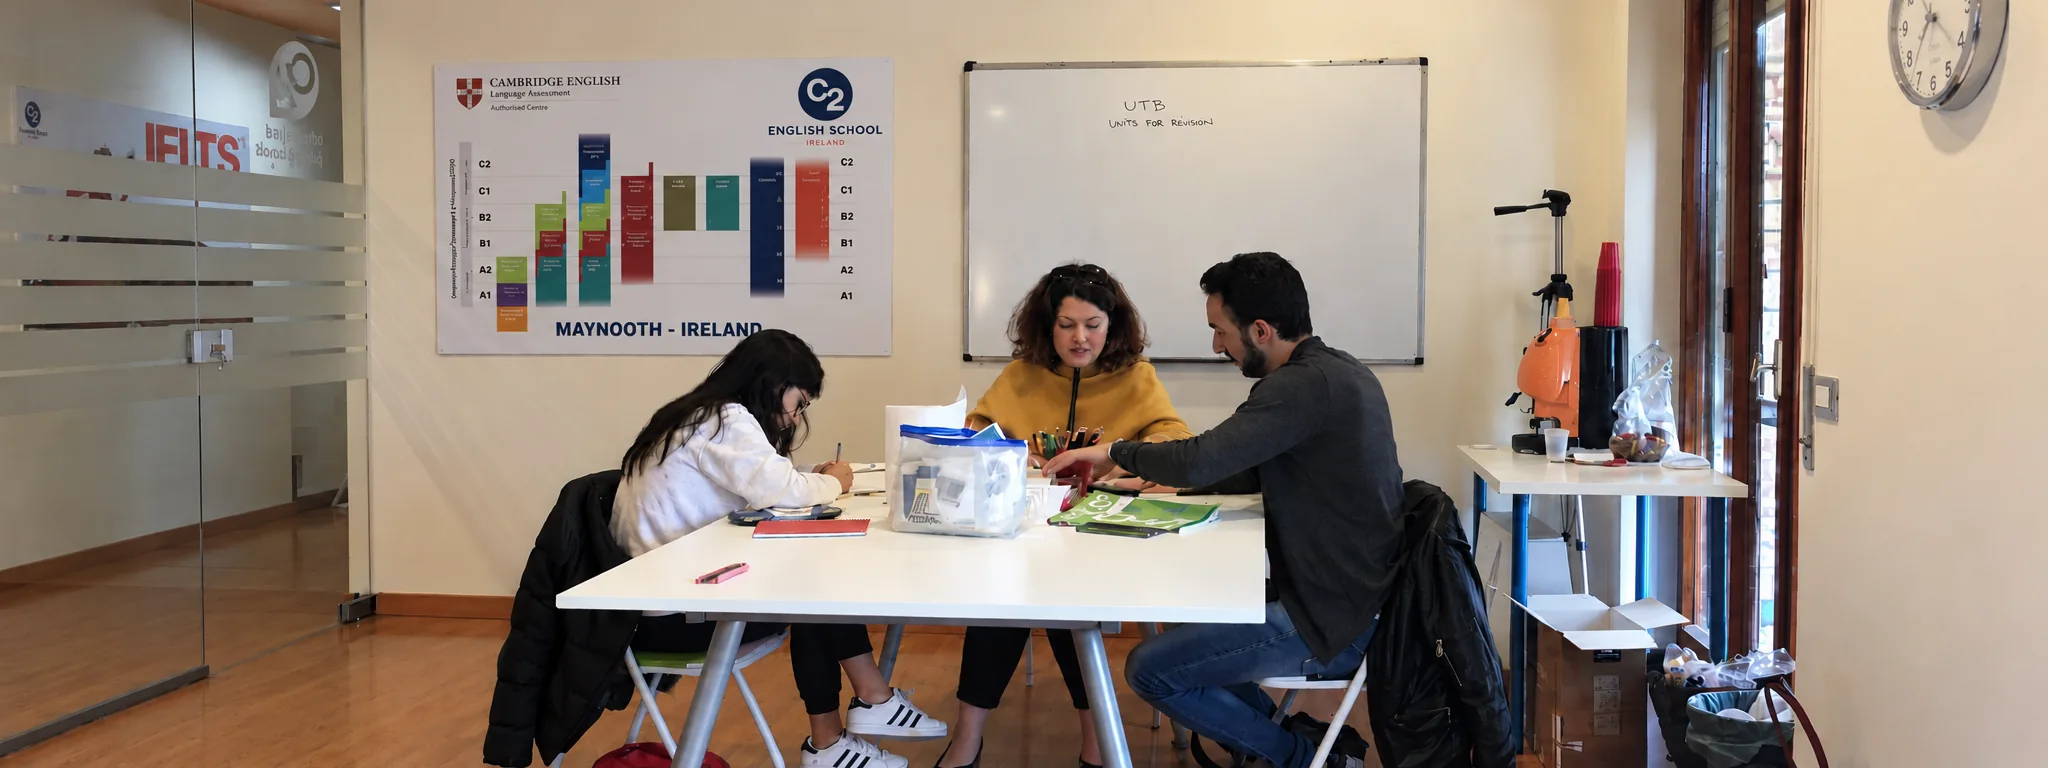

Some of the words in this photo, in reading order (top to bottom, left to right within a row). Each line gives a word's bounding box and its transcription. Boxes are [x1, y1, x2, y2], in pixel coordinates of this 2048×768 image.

[1902, 20, 1908, 37] 9
[1957, 31, 1966, 48] 4
[1906, 50, 1913, 68] 8
[1945, 60, 1952, 78] 5
[489, 77, 564, 88] CAMBRIDGE
[567, 75, 621, 87] ENGLISH
[1916, 70, 1923, 89] 7
[1930, 75, 1937, 91] 6
[490, 90, 527, 99] Language
[806, 77, 845, 112] C2
[490, 104, 526, 112] Authorised
[1123, 99, 1166, 112] UTB
[1145, 119, 1164, 127] FOR
[768, 125, 825, 136] ENGLISH
[829, 125, 883, 135] SCHOOL
[478, 160, 491, 168] C2
[840, 158, 854, 166] C2
[478, 187, 490, 195] C1
[840, 186, 853, 194] C1
[479, 213, 491, 222] B2
[840, 212, 854, 221] B2
[479, 239, 491, 248] B1
[840, 239, 853, 247] B1
[479, 266, 492, 274] A2
[840, 266, 854, 274] A2
[479, 291, 491, 299] A1
[840, 292, 853, 300] A1
[555, 321, 662, 337] MAYNOOTH
[680, 322, 763, 337] IRELAND
